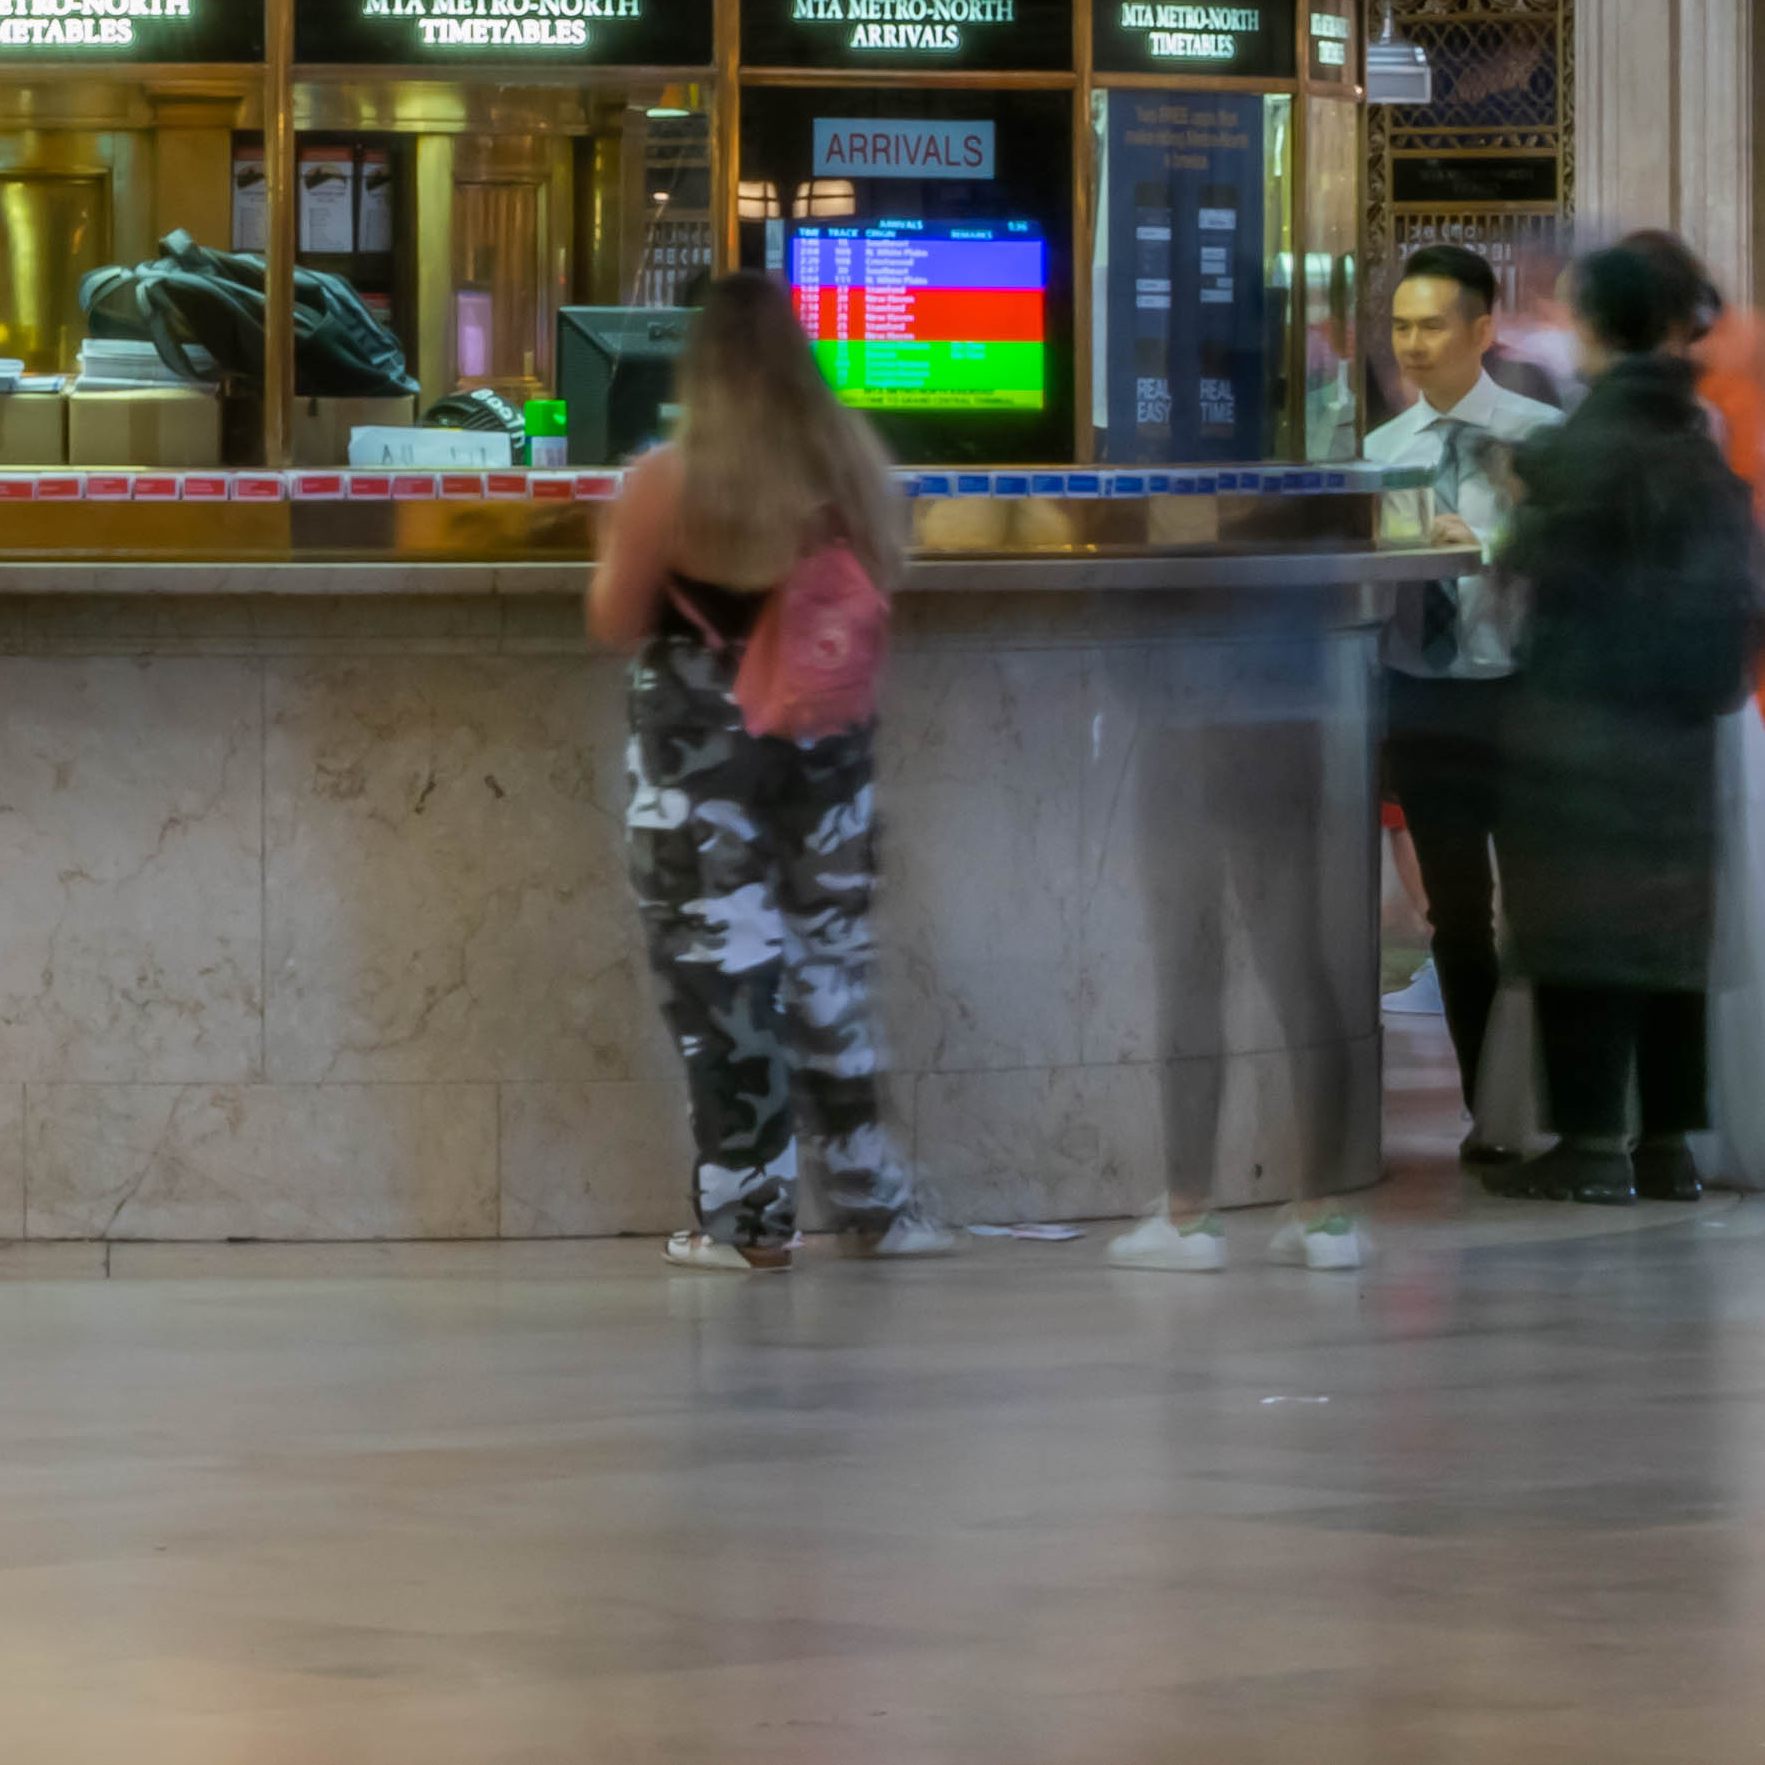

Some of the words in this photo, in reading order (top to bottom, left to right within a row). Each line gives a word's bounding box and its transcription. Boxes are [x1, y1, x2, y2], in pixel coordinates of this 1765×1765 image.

[1121, 2, 1154, 27] MTA
[1155, 5, 1259, 31] METRO-NORTH
[419, 18, 588, 44] TIMETABLES
[850, 24, 960, 48] ARRIVALS
[1149, 32, 1235, 58] TIMETABLES
[826, 132, 984, 167] ARRIVALS
[1137, 378, 1170, 399] REAL
[1200, 379, 1234, 399] REAL
[1137, 402, 1170, 423] EASY
[1201, 402, 1234, 423] TIME
